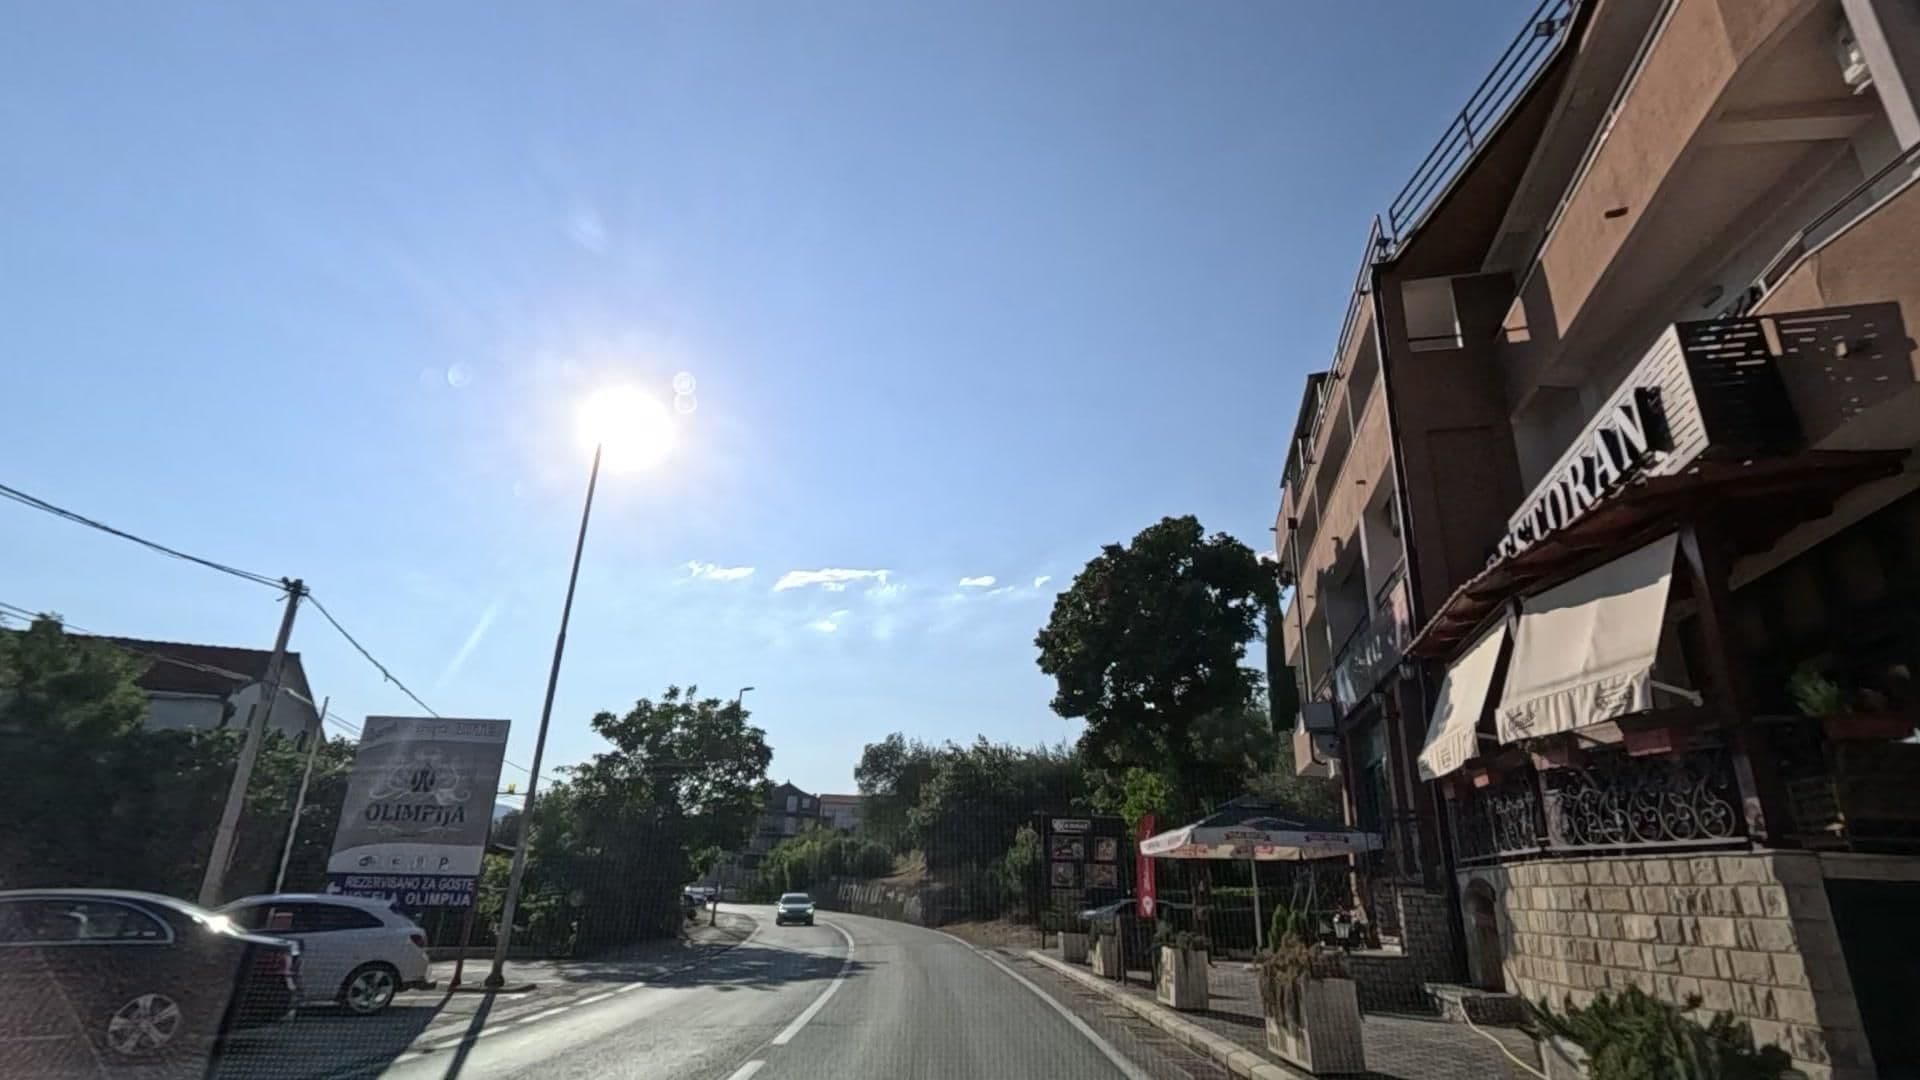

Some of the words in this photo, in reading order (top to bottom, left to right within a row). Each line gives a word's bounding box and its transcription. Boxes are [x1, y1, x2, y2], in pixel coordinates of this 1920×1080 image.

[365, 803, 465, 827] OLIMPIJA
[344, 875, 420, 889] REZERVISANO
[421, 877, 436, 890] ZA
[438, 878, 474, 891] GOSTE
[404, 890, 472, 906] OLIMPIJA
